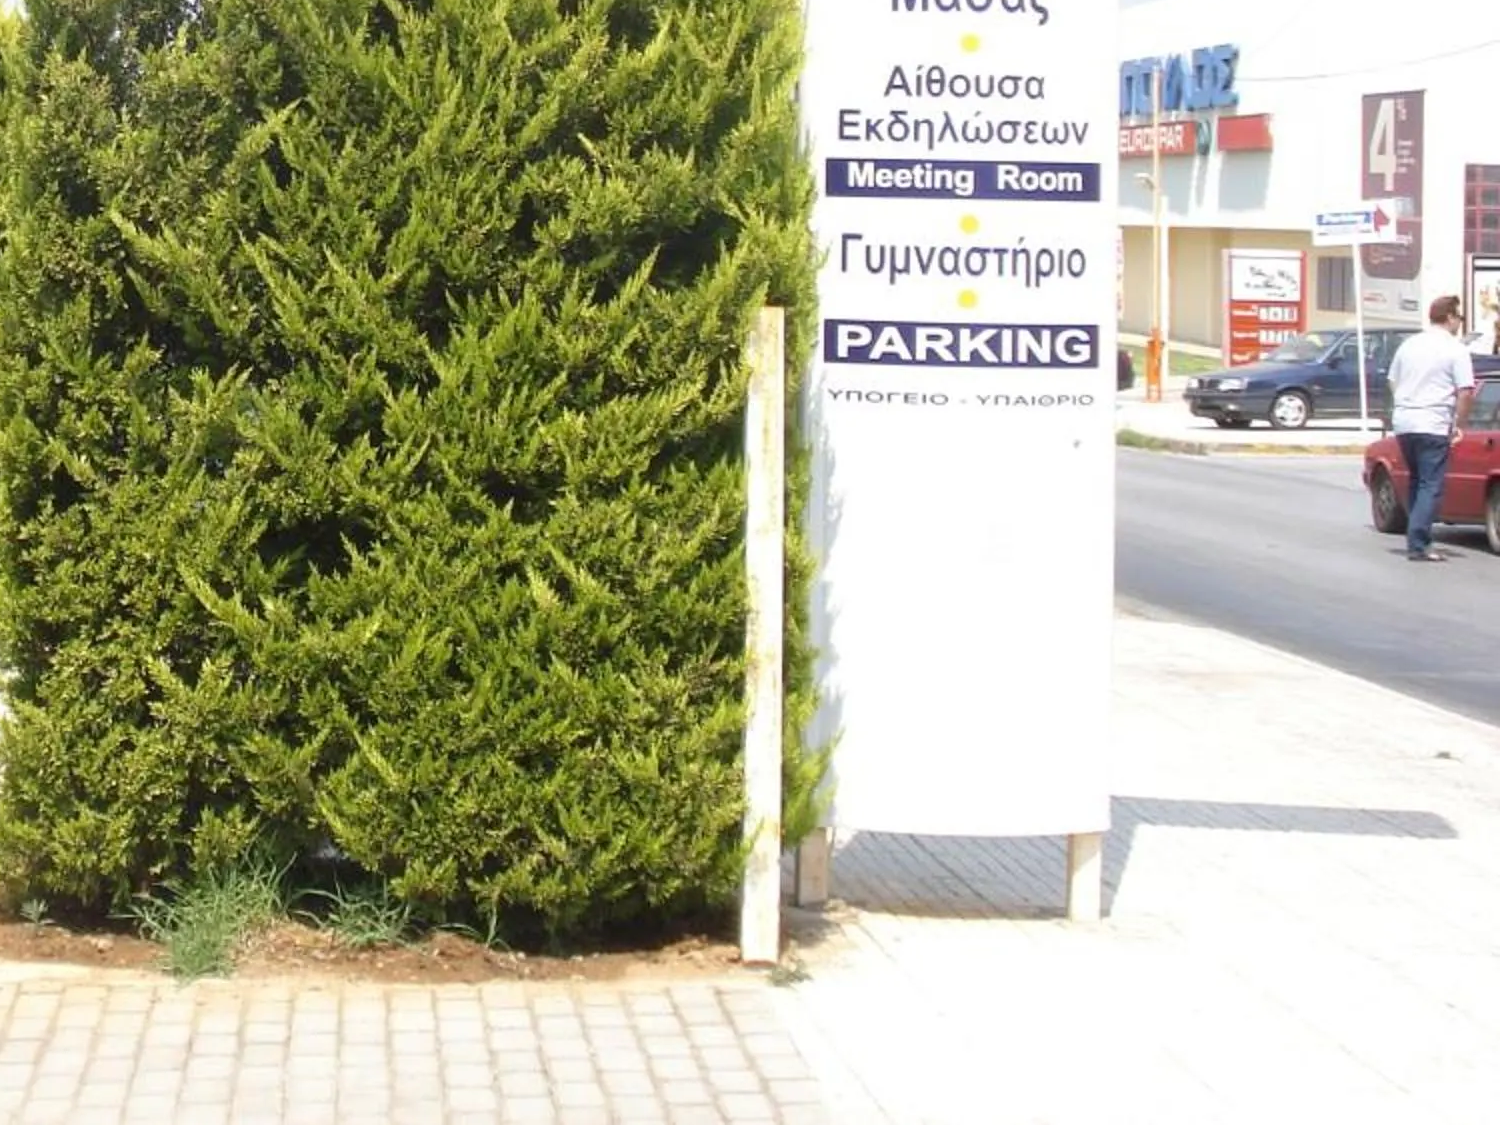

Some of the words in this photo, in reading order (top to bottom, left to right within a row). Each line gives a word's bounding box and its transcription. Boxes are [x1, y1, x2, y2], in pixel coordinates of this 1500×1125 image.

[883, 64, 1046, 100] Αίθουσα
[838, 108, 1089, 151] Εκδηλώσεων
[1119, 124, 1185, 153] EUROPAR
[1368, 97, 1397, 192] 4
[847, 161, 975, 196] Meeting
[996, 164, 1084, 193] Room
[840, 232, 1087, 288] Γυμναστήριο
[836, 324, 1092, 364] PARKING
[827, 388, 949, 406] ΥΠΟΓΕΙΟ
